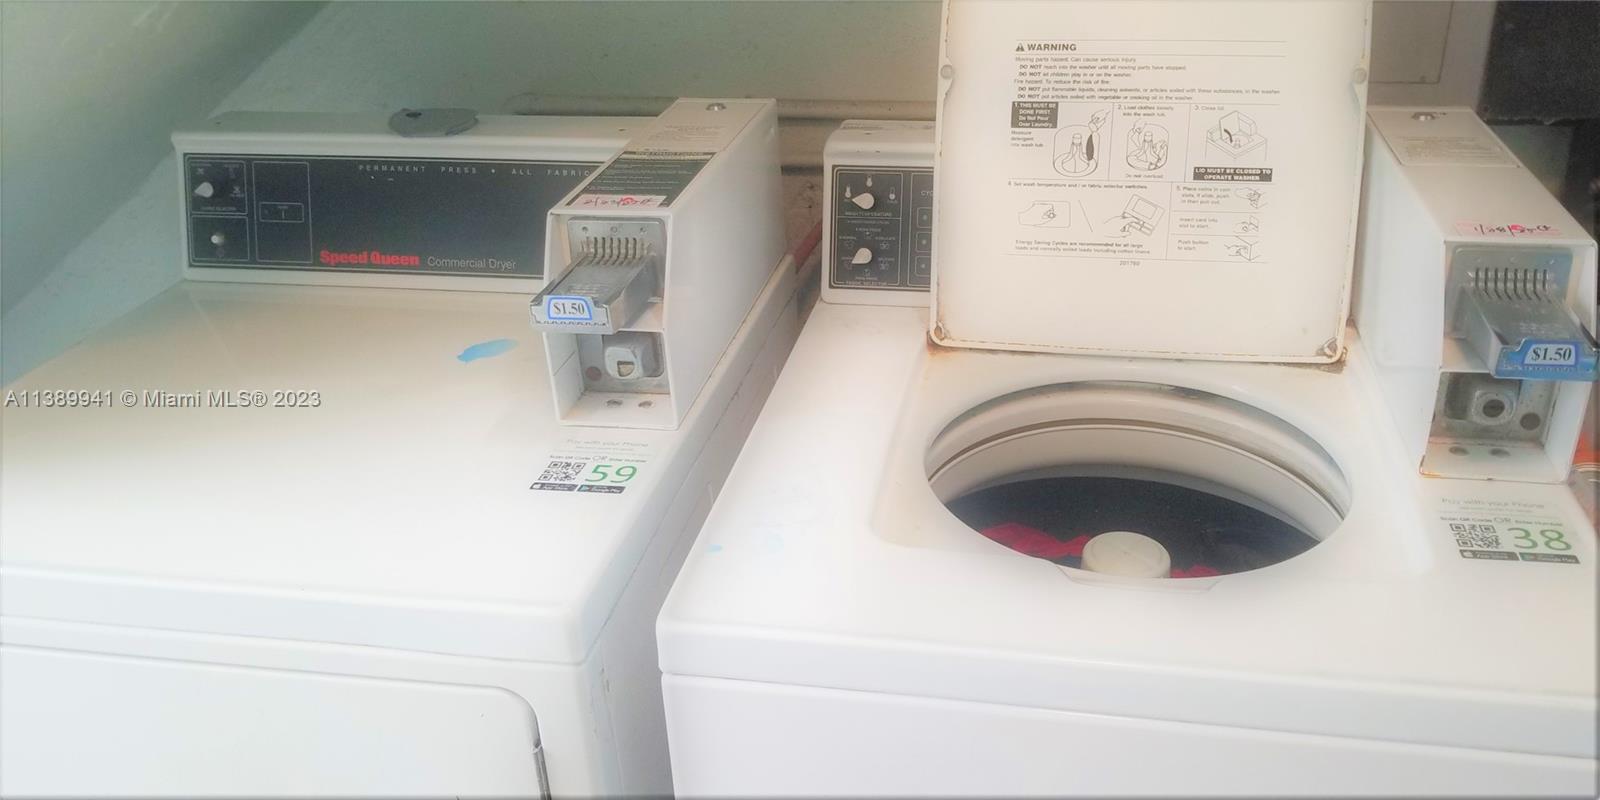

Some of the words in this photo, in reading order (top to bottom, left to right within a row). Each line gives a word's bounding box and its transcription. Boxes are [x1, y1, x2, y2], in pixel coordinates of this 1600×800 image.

[1026, 43, 1078, 51] WARNING
[358, 164, 426, 173] PERMANENT
[440, 166, 478, 175] PRESS
[511, 168, 532, 176] ALL
[546, 168, 592, 177] FABRIC
[319, 250, 368, 266] Speed
[370, 252, 420, 266] Queen
[427, 256, 486, 269] Commercial
[488, 258, 516, 272] Dryer
[553, 302, 585, 315] $1.50
[1531, 347, 1572, 362] $1.50
[584, 464, 638, 483] 59
[1506, 527, 1572, 551] 38
